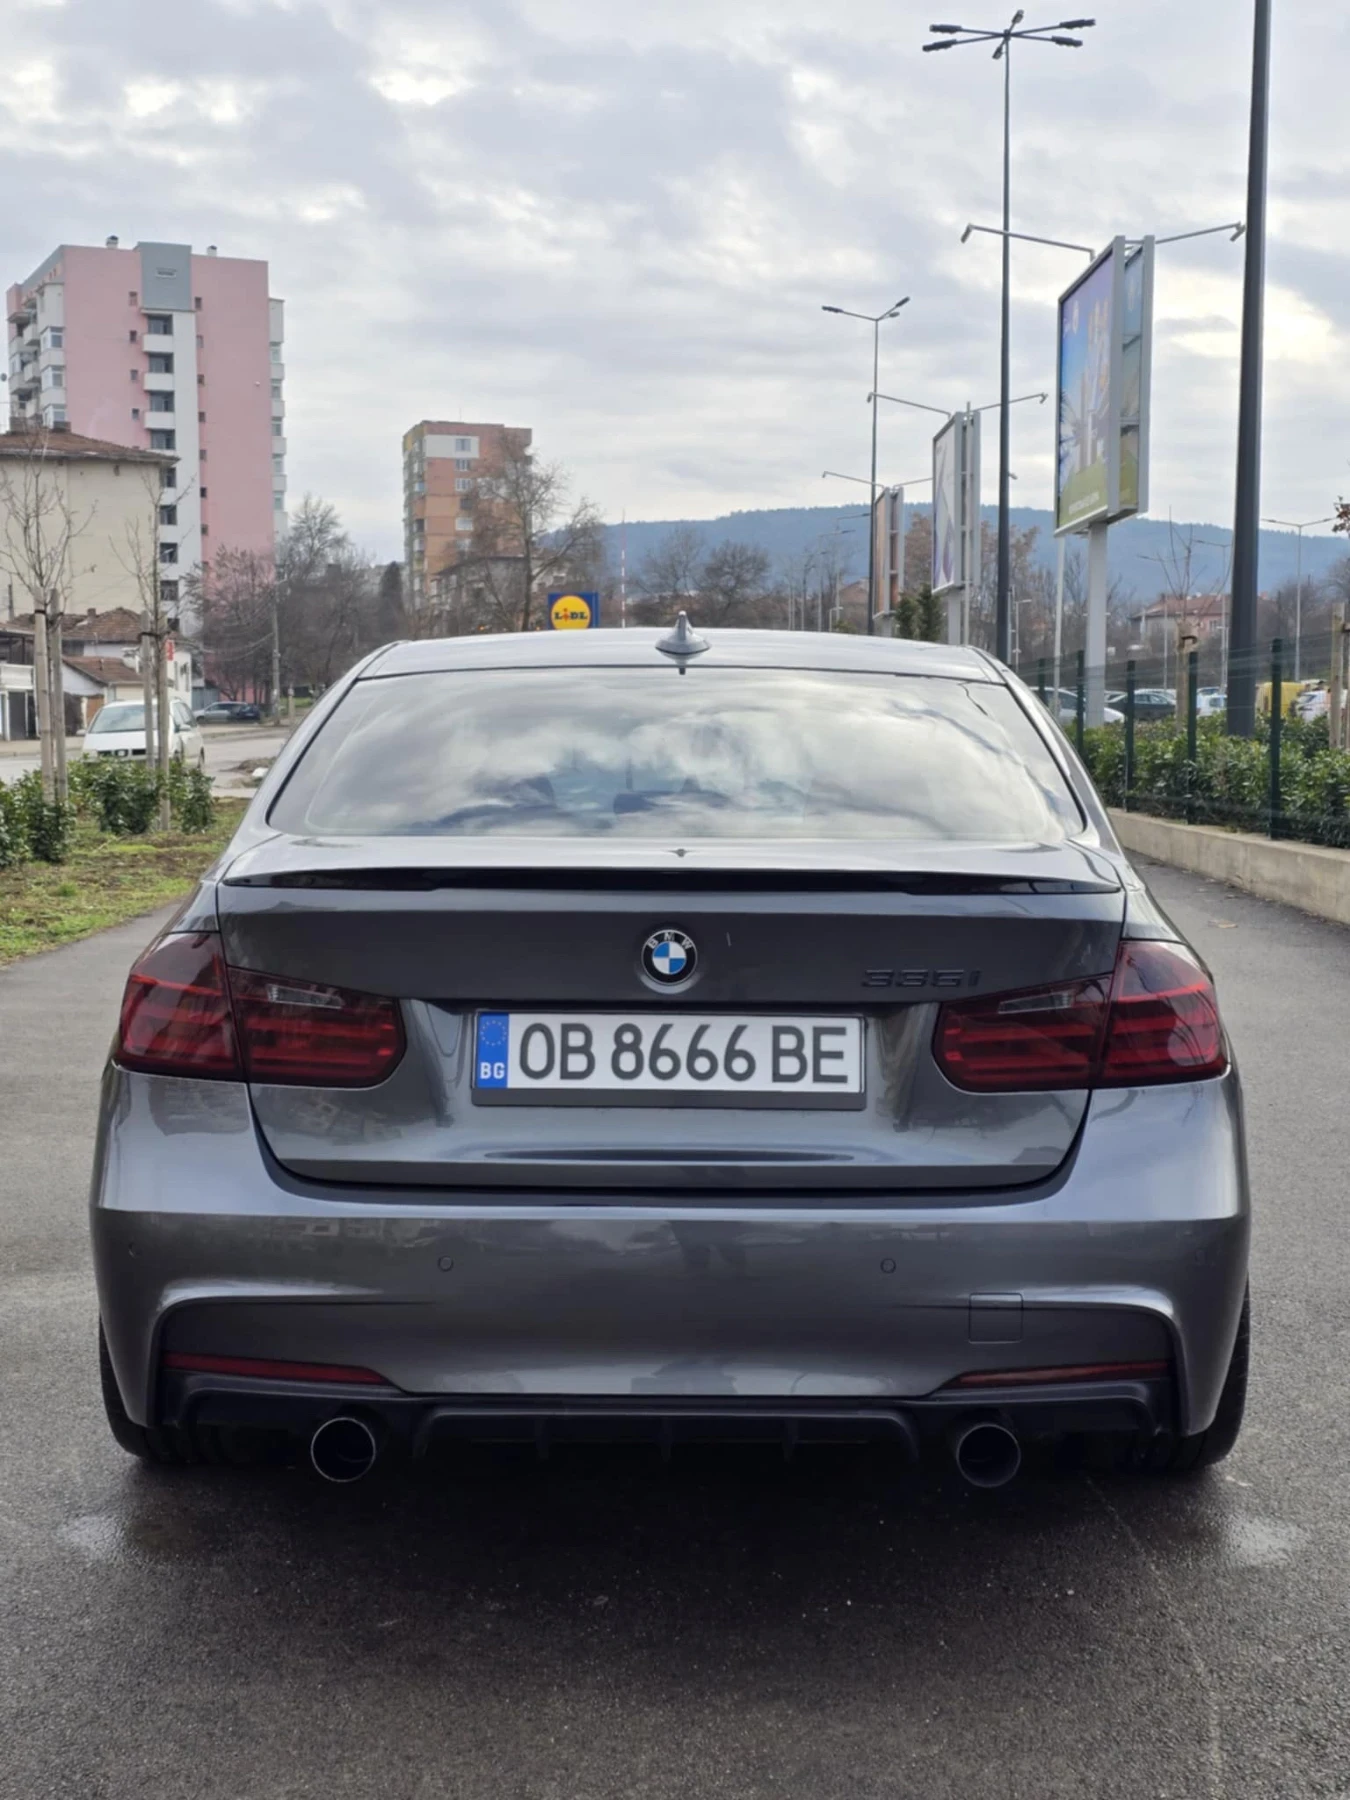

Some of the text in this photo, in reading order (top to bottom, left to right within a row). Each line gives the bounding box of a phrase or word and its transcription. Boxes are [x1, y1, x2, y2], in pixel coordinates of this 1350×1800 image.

[646, 932, 693, 949] BMW
[519, 1022, 849, 1084] OB 8666 BE
[480, 1062, 505, 1080] BG
